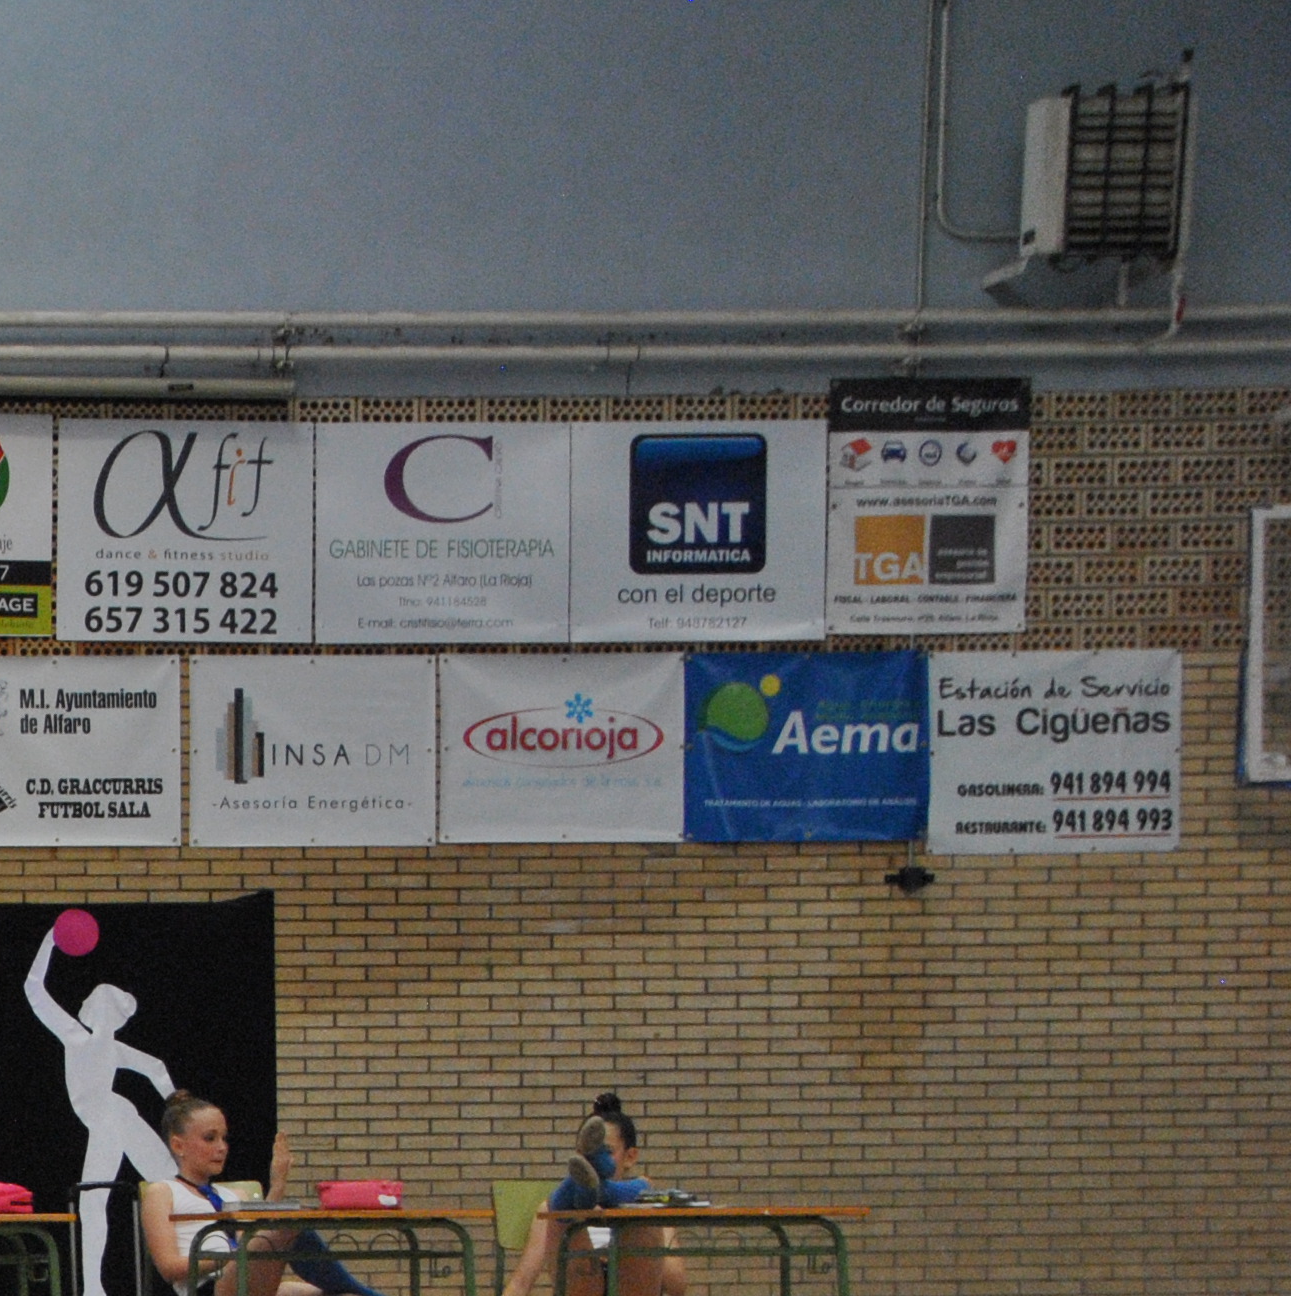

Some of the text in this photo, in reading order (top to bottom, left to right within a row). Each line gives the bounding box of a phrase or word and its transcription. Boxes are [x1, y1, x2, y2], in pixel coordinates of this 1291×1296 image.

[841, 395, 1019, 418] Corredor de Seguros
[646, 501, 750, 545] SNT
[95, 548, 269, 561] dance & fitness studio
[329, 538, 555, 559] GABINETE DE FISIOTERAPIA
[854, 551, 924, 581] TGA
[85, 570, 278, 599] 619 507 824
[443, 574, 477, 587] Alfaro
[617, 583, 776, 607] con el deporte
[84, 606, 277, 635] 657 315 422
[939, 675, 1169, 699] Estación de Servicio
[19, 688, 157, 712] M.I. Ayuntamiento
[20, 714, 91, 734] de Alfaro
[771, 710, 919, 754] Aema
[937, 709, 996, 737] Las
[1016, 707, 1171, 743] Cigüeñas
[486, 715, 638, 759] alcorioja
[272, 743, 409, 766] INSA DM
[25, 778, 163, 795] C.D. GRACCURRIS
[1050, 771, 1083, 795] 941
[1090, 770, 1126, 794] 894
[1133, 769, 1171, 793] 994
[38, 801, 151, 818] FUTBOL SALA
[1052, 809, 1086, 833] 941
[1093, 808, 1130, 832] 894
[1137, 807, 1173, 831] 993
